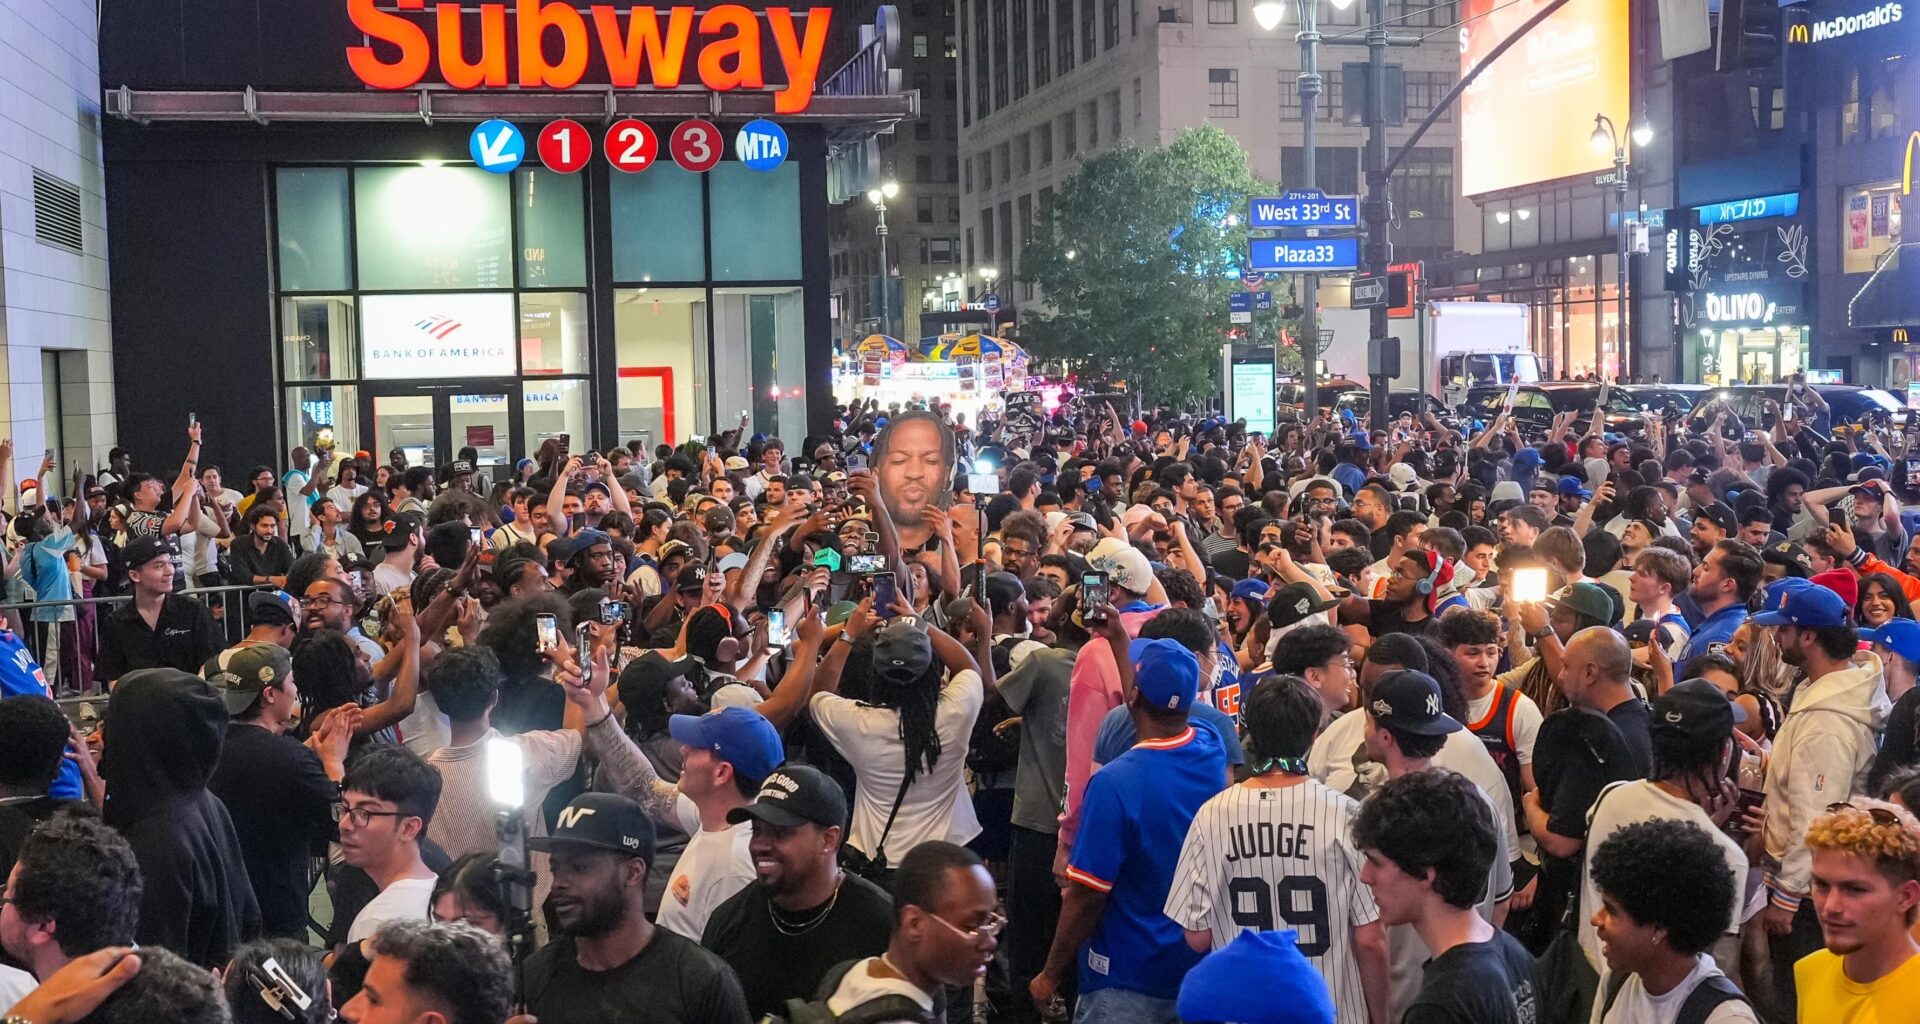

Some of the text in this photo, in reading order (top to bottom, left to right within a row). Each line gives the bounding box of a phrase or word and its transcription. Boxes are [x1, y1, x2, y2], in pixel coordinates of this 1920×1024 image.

[1812, 3, 1902, 43] McDonald's
[346, 0, 832, 114] Subway
[552, 127, 571, 163] 1
[618, 128, 645, 164] 2
[683, 128, 711, 162] 3
[737, 130, 782, 160] MTA
[1258, 202, 1350, 220] West 33rd St
[1274, 245, 1334, 263] Plaza33
[1724, 270, 1768, 281] UPSTAIRS DINING
[1356, 288, 1368, 299] ONE
[1706, 293, 1762, 321] OLIVO
[1775, 305, 1797, 314] EATERY
[373, 347, 505, 359] BANK OF AMERICA
[1227, 822, 1314, 861] JUDGE
[1229, 875, 1331, 957] 99
